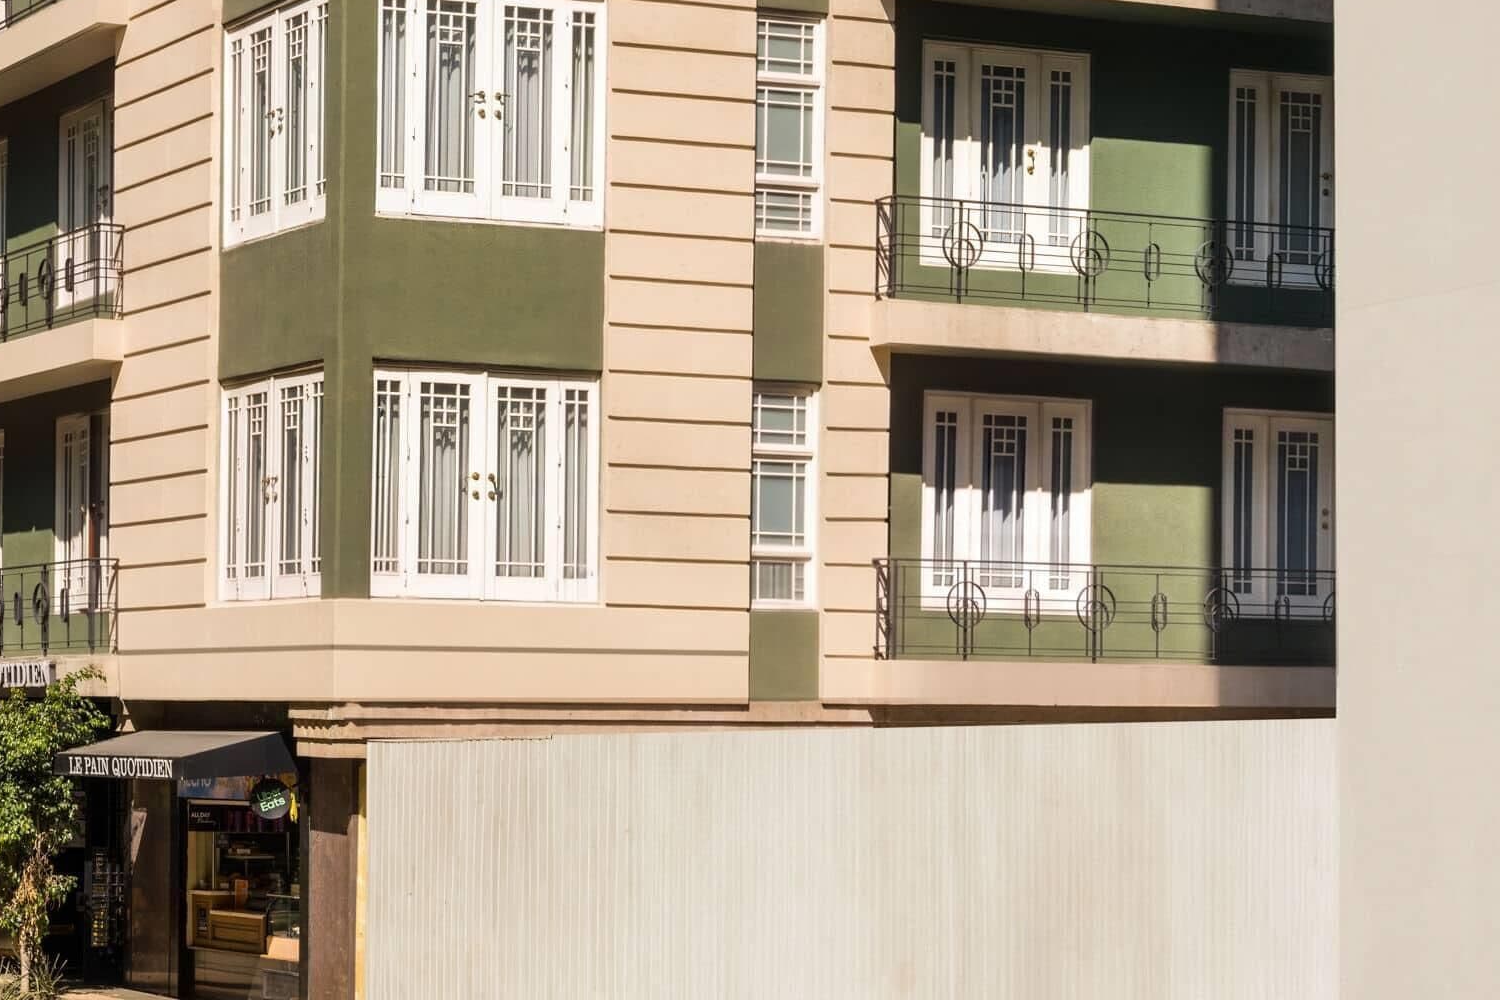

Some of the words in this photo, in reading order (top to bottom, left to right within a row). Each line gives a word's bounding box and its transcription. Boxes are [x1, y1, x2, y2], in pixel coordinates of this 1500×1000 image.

[68, 756, 83, 775] LE
[85, 757, 109, 775] PAIN
[111, 757, 173, 779] QUOTIDIEN
[260, 796, 287, 812] Eats
